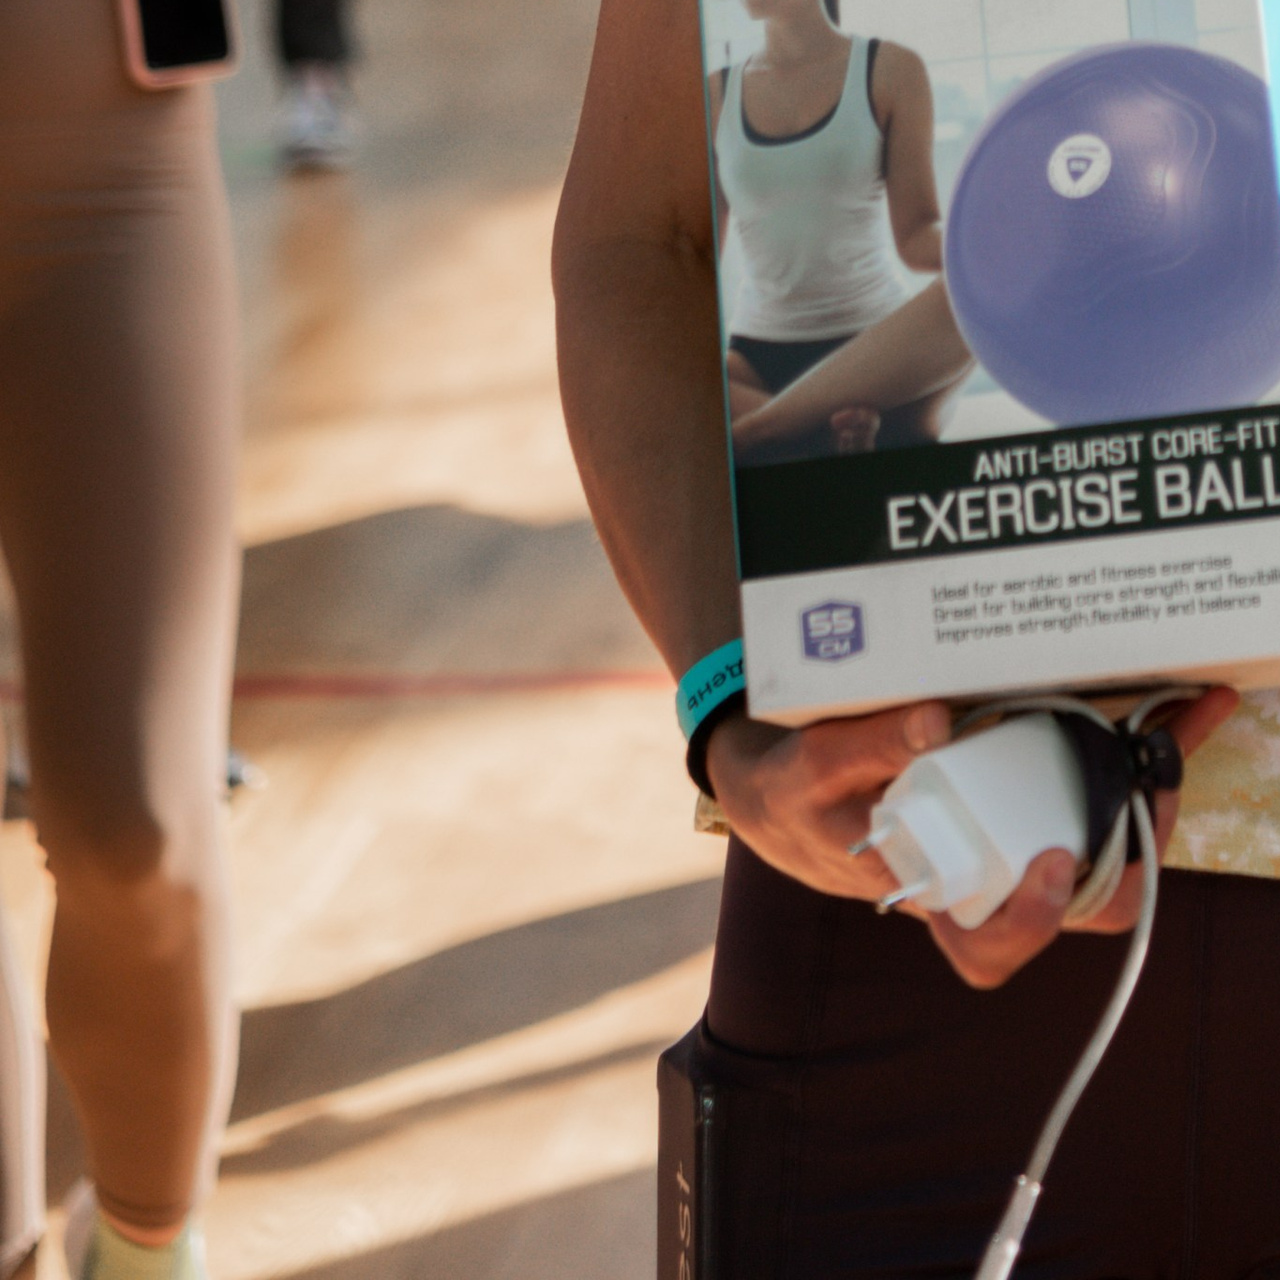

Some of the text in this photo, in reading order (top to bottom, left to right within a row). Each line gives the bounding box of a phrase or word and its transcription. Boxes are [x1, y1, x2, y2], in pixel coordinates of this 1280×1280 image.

[974, 417, 1280, 482] ANTI-BURST CORE-FIT
[886, 470, 1142, 551] EXERCISE
[932, 554, 1233, 602] Ideal for aerobic and fitness exercise
[934, 601, 977, 624] Great
[982, 600, 1005, 617] for
[1011, 591, 1072, 614] building
[1075, 589, 1113, 607] core
[1118, 578, 1190, 601] strength
[1194, 575, 1223, 593] and
[809, 607, 855, 638] 55
[935, 621, 1014, 644] Improves
[1166, 600, 1195, 618] and
[1200, 592, 1261, 614] balance
